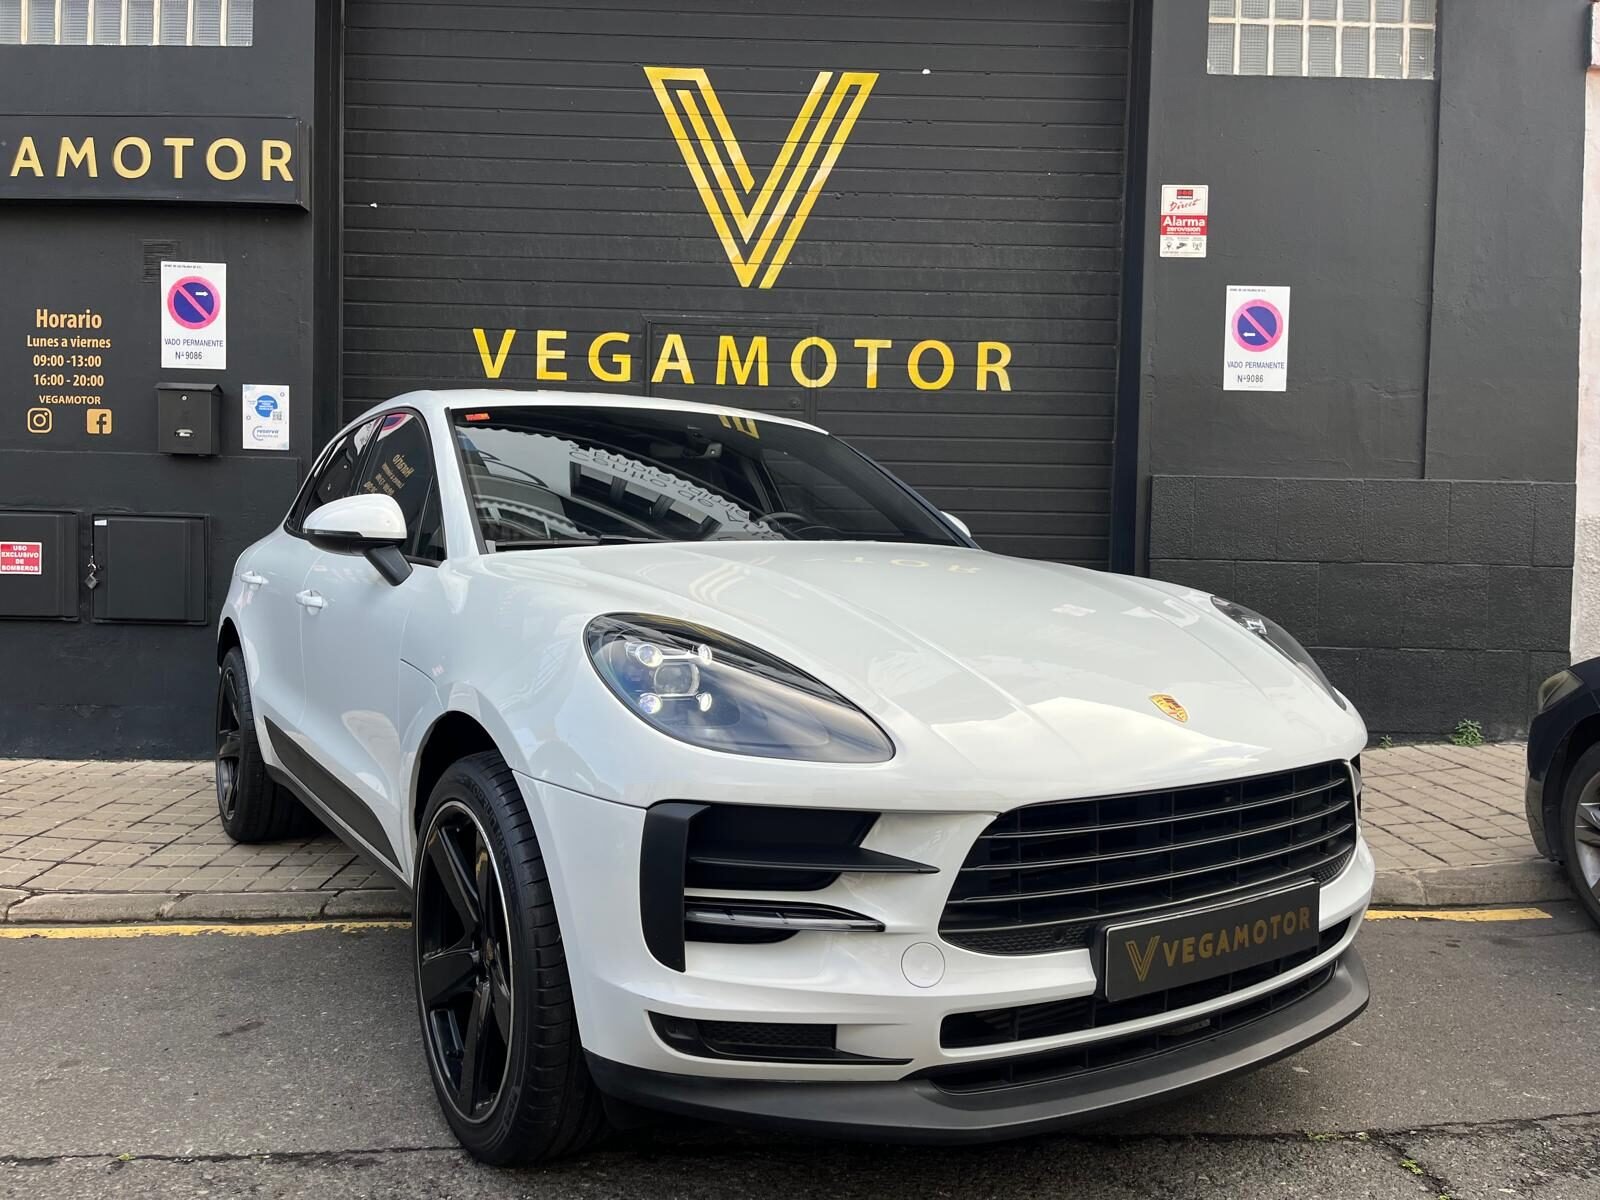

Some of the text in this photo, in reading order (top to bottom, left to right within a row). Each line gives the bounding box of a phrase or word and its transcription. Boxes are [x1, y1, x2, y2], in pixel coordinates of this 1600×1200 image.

[9, 136, 294, 182] AMOTOR
[1163, 215, 1205, 227] Alarma
[36, 309, 102, 328] Horario
[27, 335, 111, 348] Lunes a viernes
[164, 338, 224, 347] VADO PERMANENTE
[33, 355, 64, 366] 09:00
[185, 352, 203, 360] 9086
[473, 328, 1012, 391] VEGAMOTOR
[1245, 361, 1285, 369] PERMANENTE
[33, 374, 64, 385] 16:00
[73, 375, 104, 386] 20:00
[39, 395, 101, 404] VEGAMOTOR
[1163, 907, 1310, 967] VEGAMOTOR
